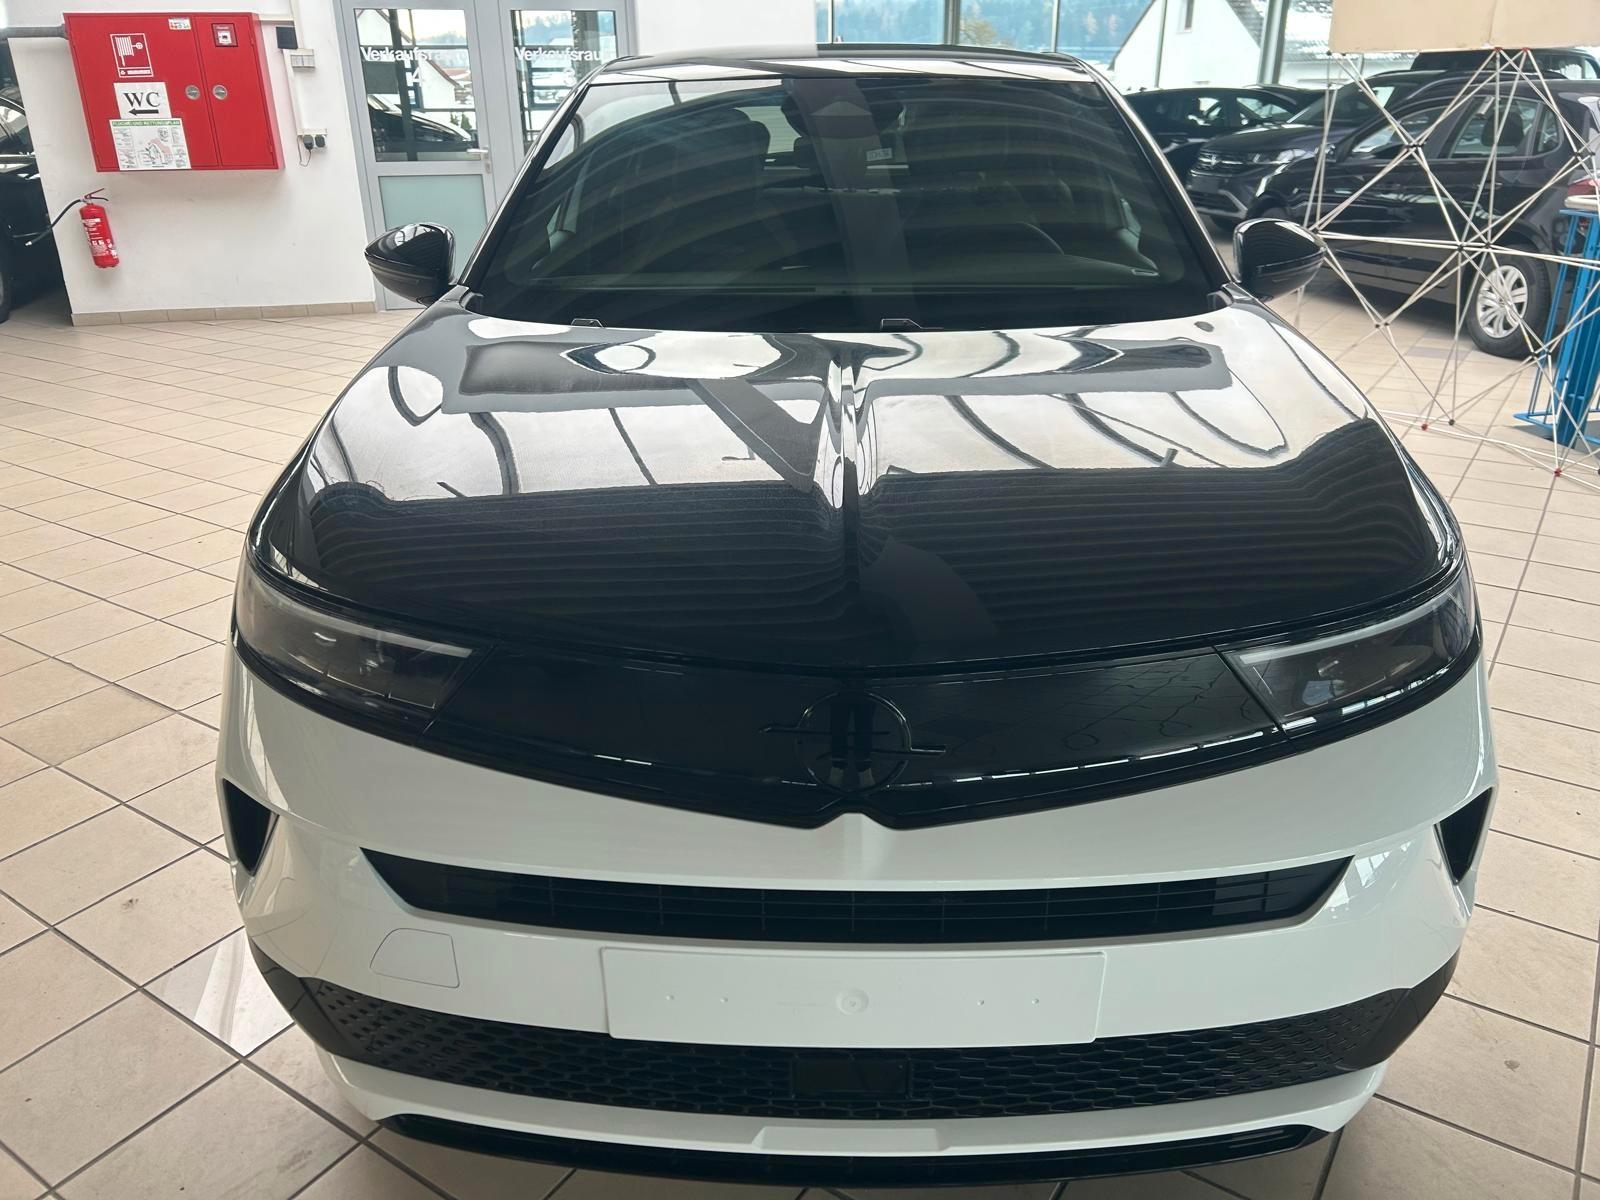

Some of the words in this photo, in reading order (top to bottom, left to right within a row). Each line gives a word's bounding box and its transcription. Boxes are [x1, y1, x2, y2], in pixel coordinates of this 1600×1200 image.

[360, 46, 460, 61] Verkaufsr
[514, 46, 608, 61] Verkaufsrau
[123, 91, 161, 108] WC
